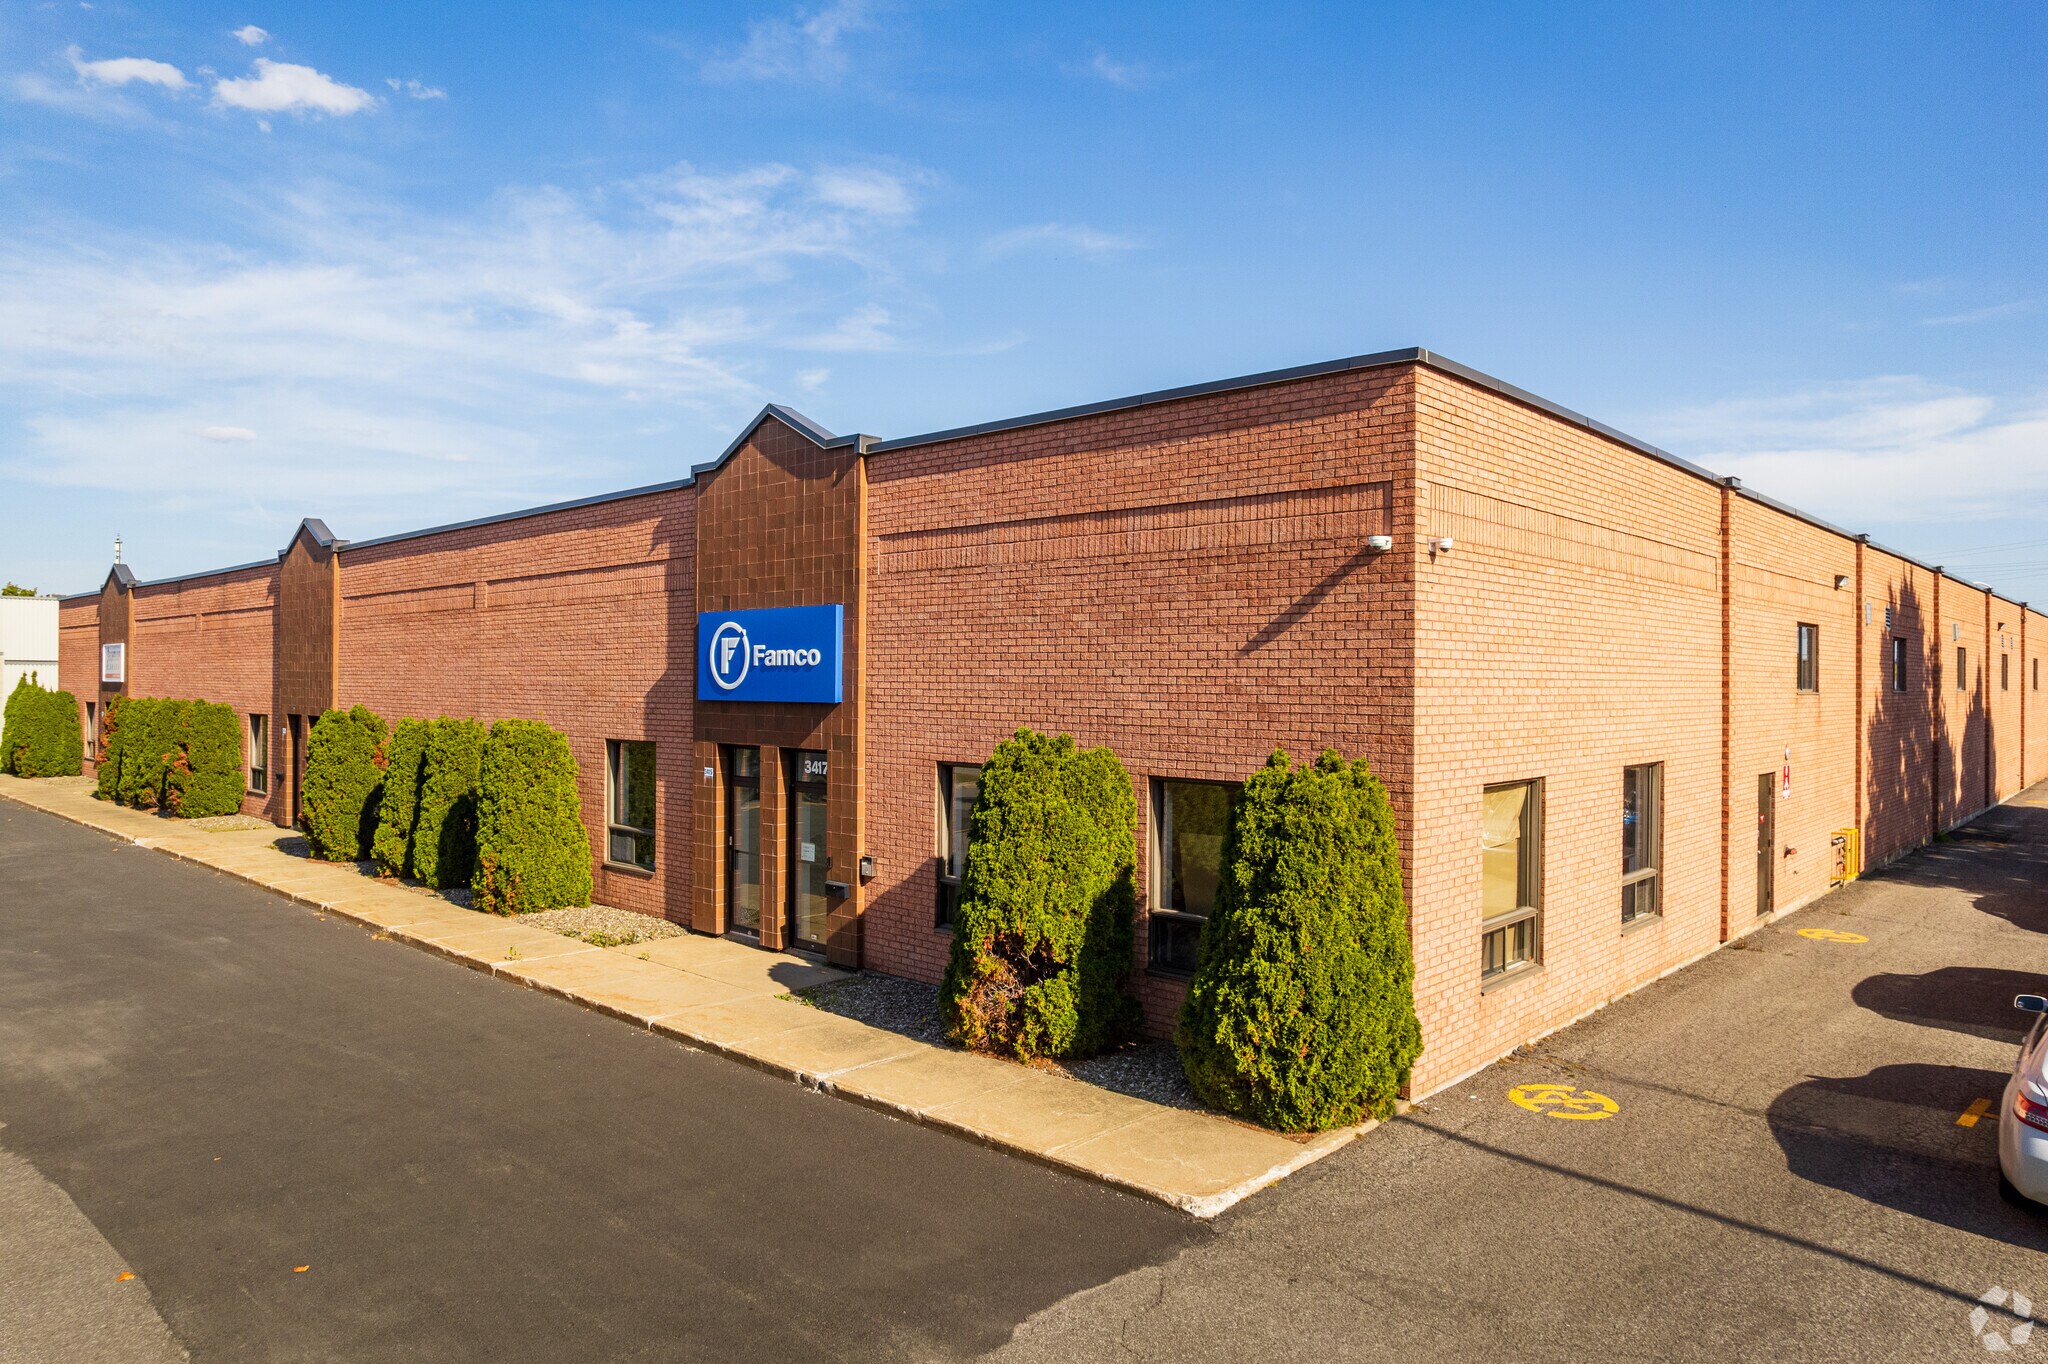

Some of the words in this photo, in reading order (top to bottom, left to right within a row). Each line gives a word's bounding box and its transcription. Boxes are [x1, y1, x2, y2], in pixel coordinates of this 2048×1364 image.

[721, 637, 740, 674] F
[753, 645, 821, 666] Famco
[805, 760, 827, 774] 3417
